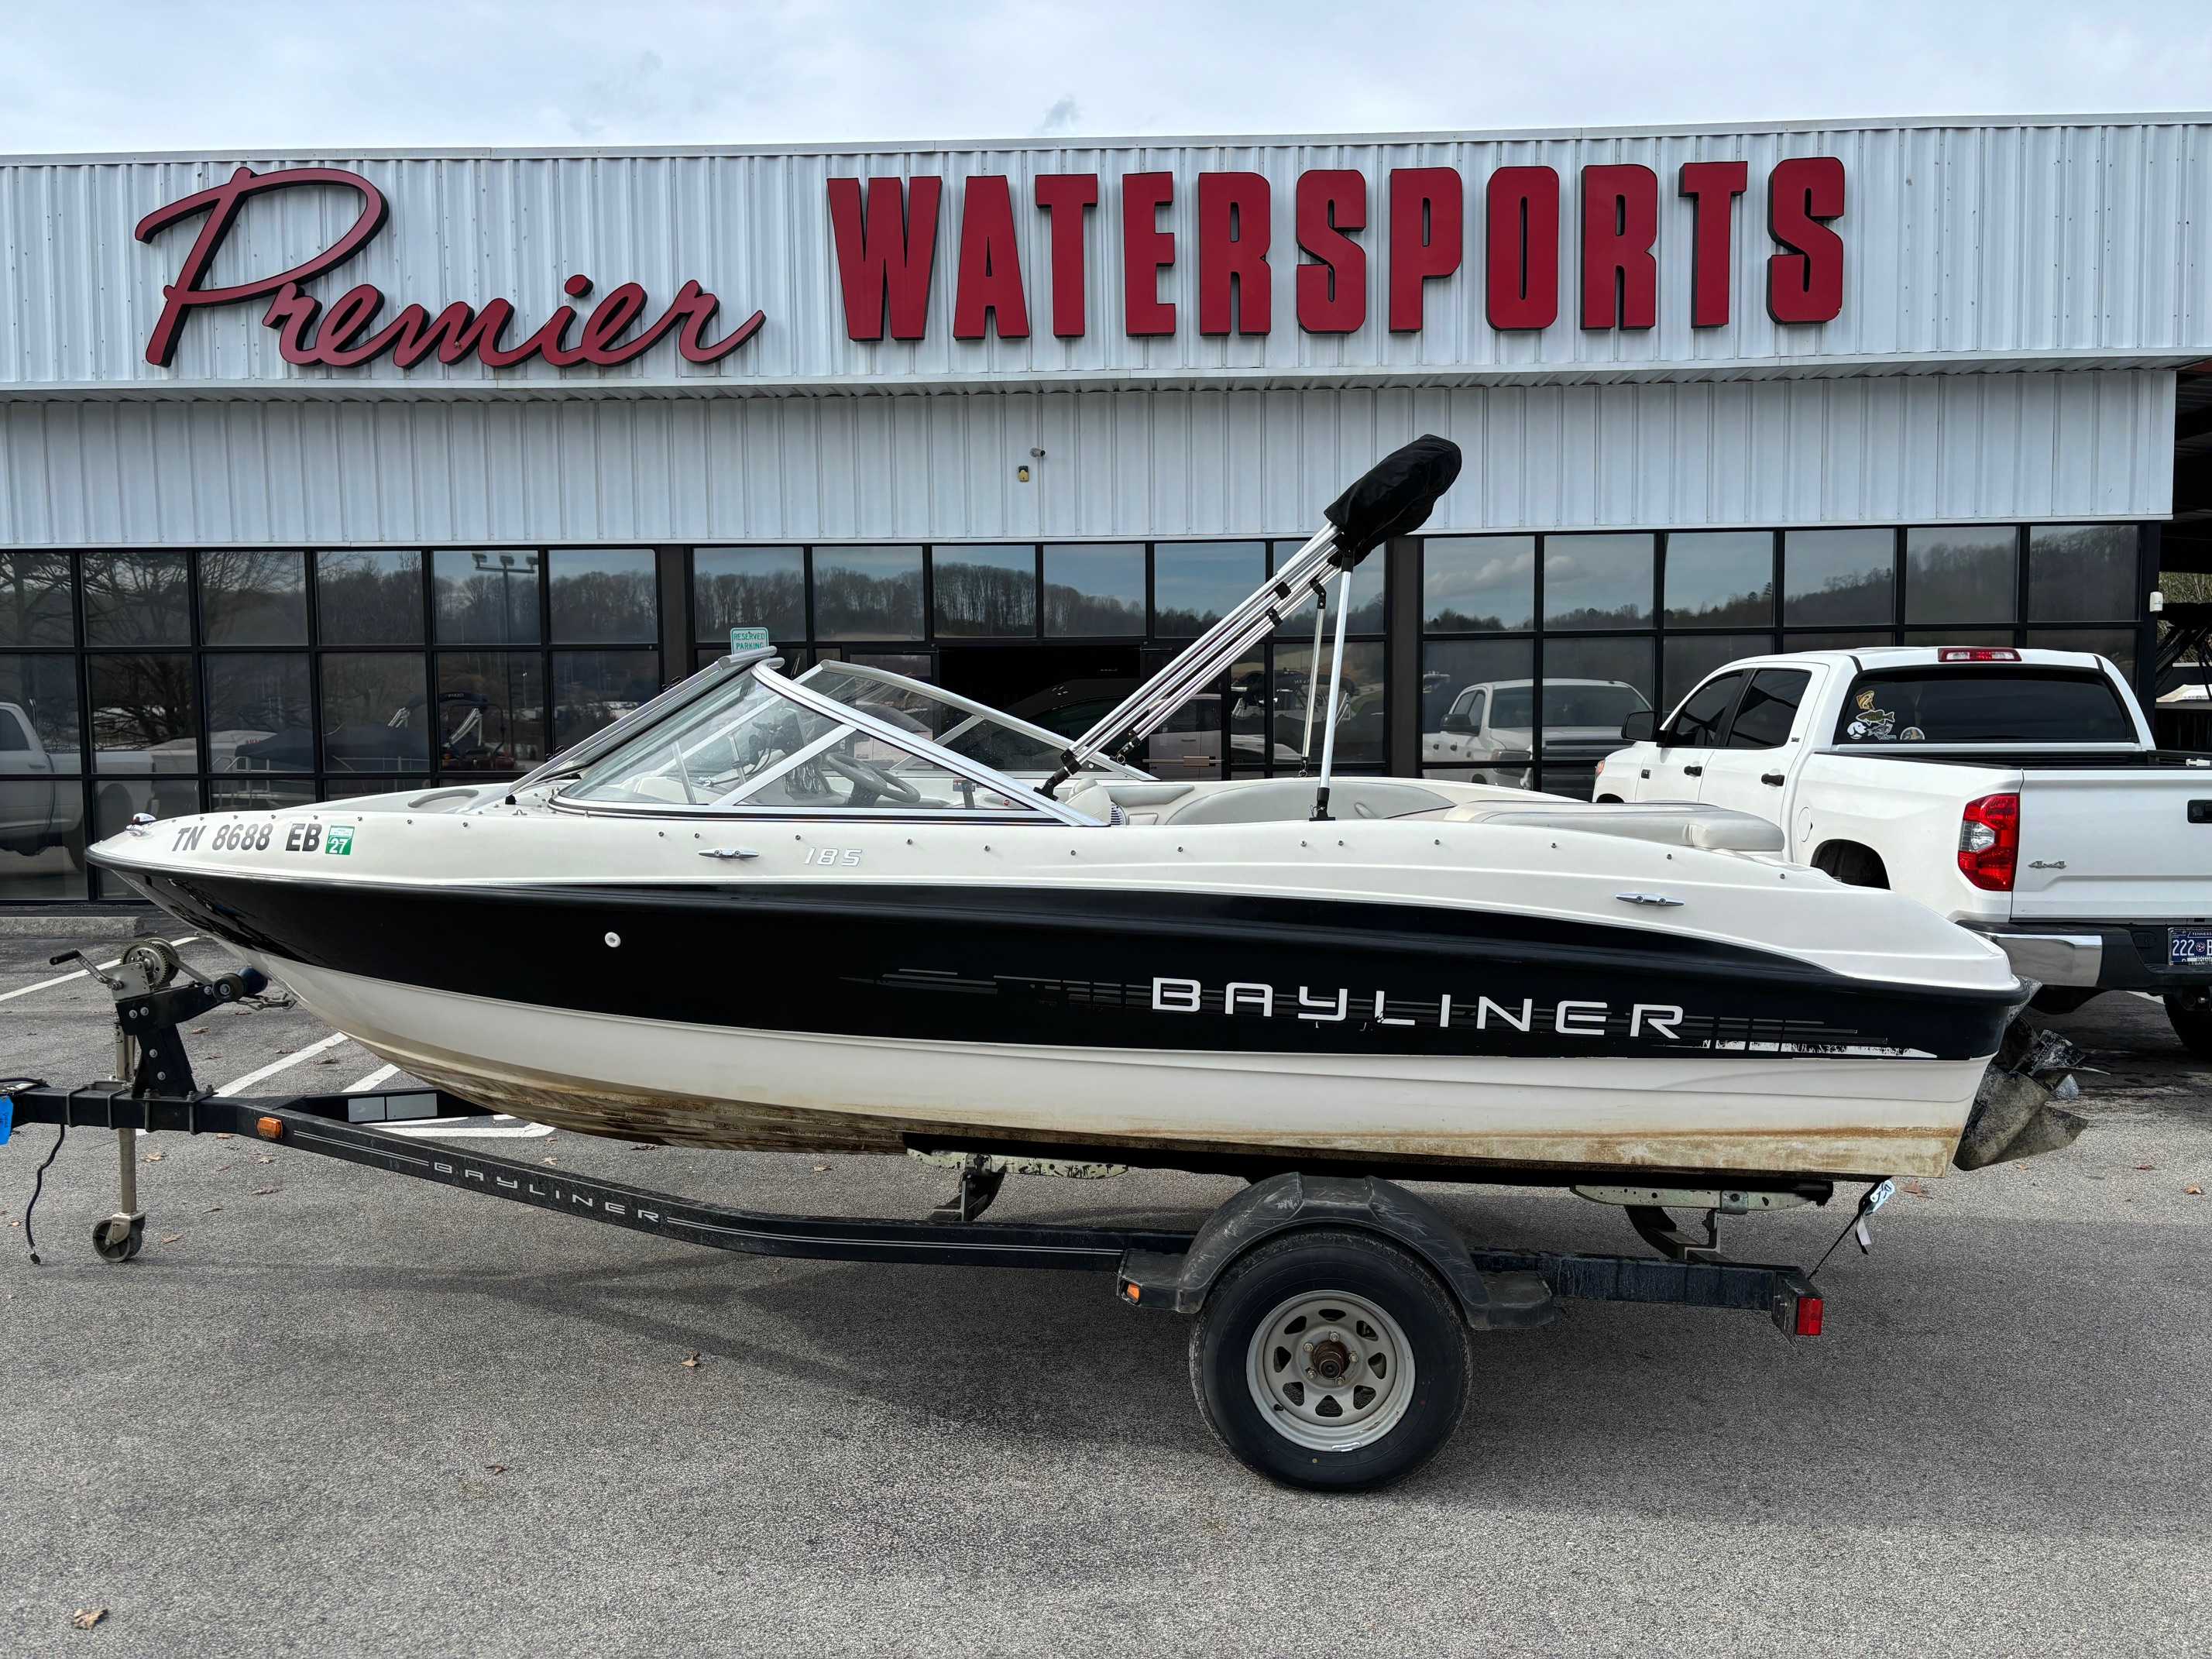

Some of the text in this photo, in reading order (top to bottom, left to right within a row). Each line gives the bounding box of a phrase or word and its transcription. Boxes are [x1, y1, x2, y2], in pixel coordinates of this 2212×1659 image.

[134, 156, 1845, 369] Premier WATERSPORTS
[172, 823, 322, 852] TN 8688 EB
[328, 837, 349, 854] 27
[802, 847, 863, 867] 185
[2172, 939, 2195, 957] 222
[1152, 977, 1684, 1039] BAYLINER
[434, 1162, 659, 1223] BAYLINER
